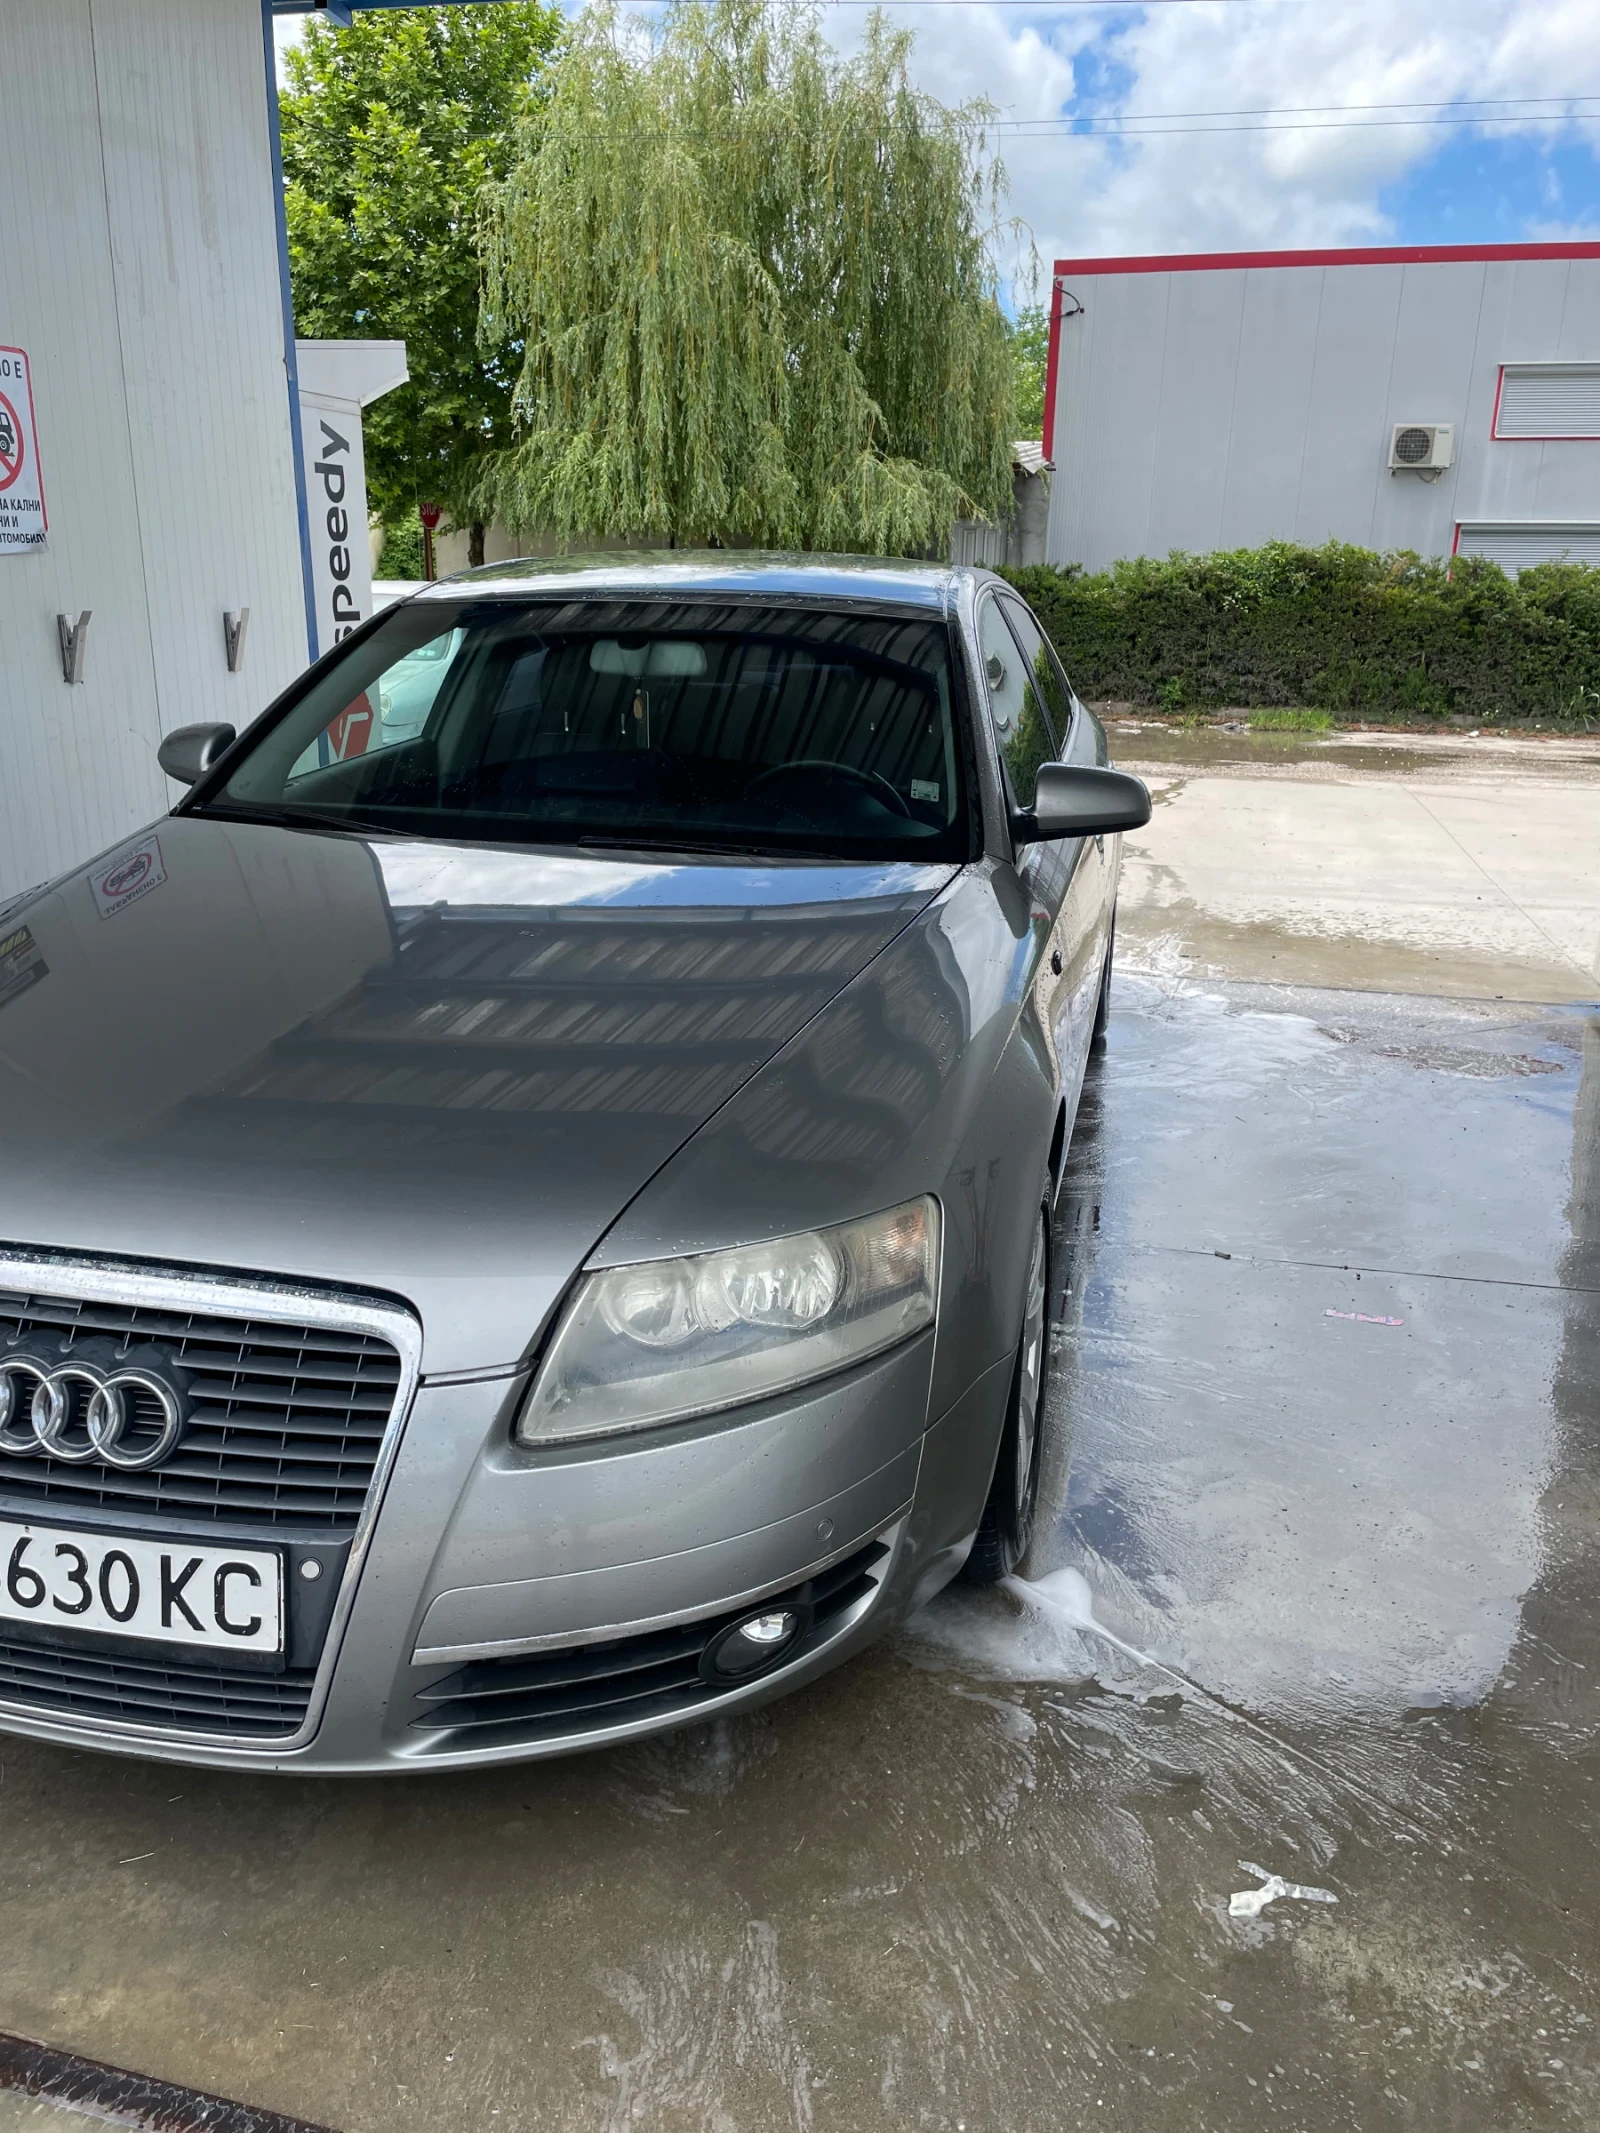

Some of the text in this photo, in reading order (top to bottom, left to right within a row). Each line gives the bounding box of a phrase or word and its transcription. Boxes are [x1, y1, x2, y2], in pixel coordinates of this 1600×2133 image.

[0, 359, 22, 379] О Е
[10, 499, 41, 511] КАЛНИ
[12, 516, 19, 527] И
[0, 1536, 140, 1623] 630
